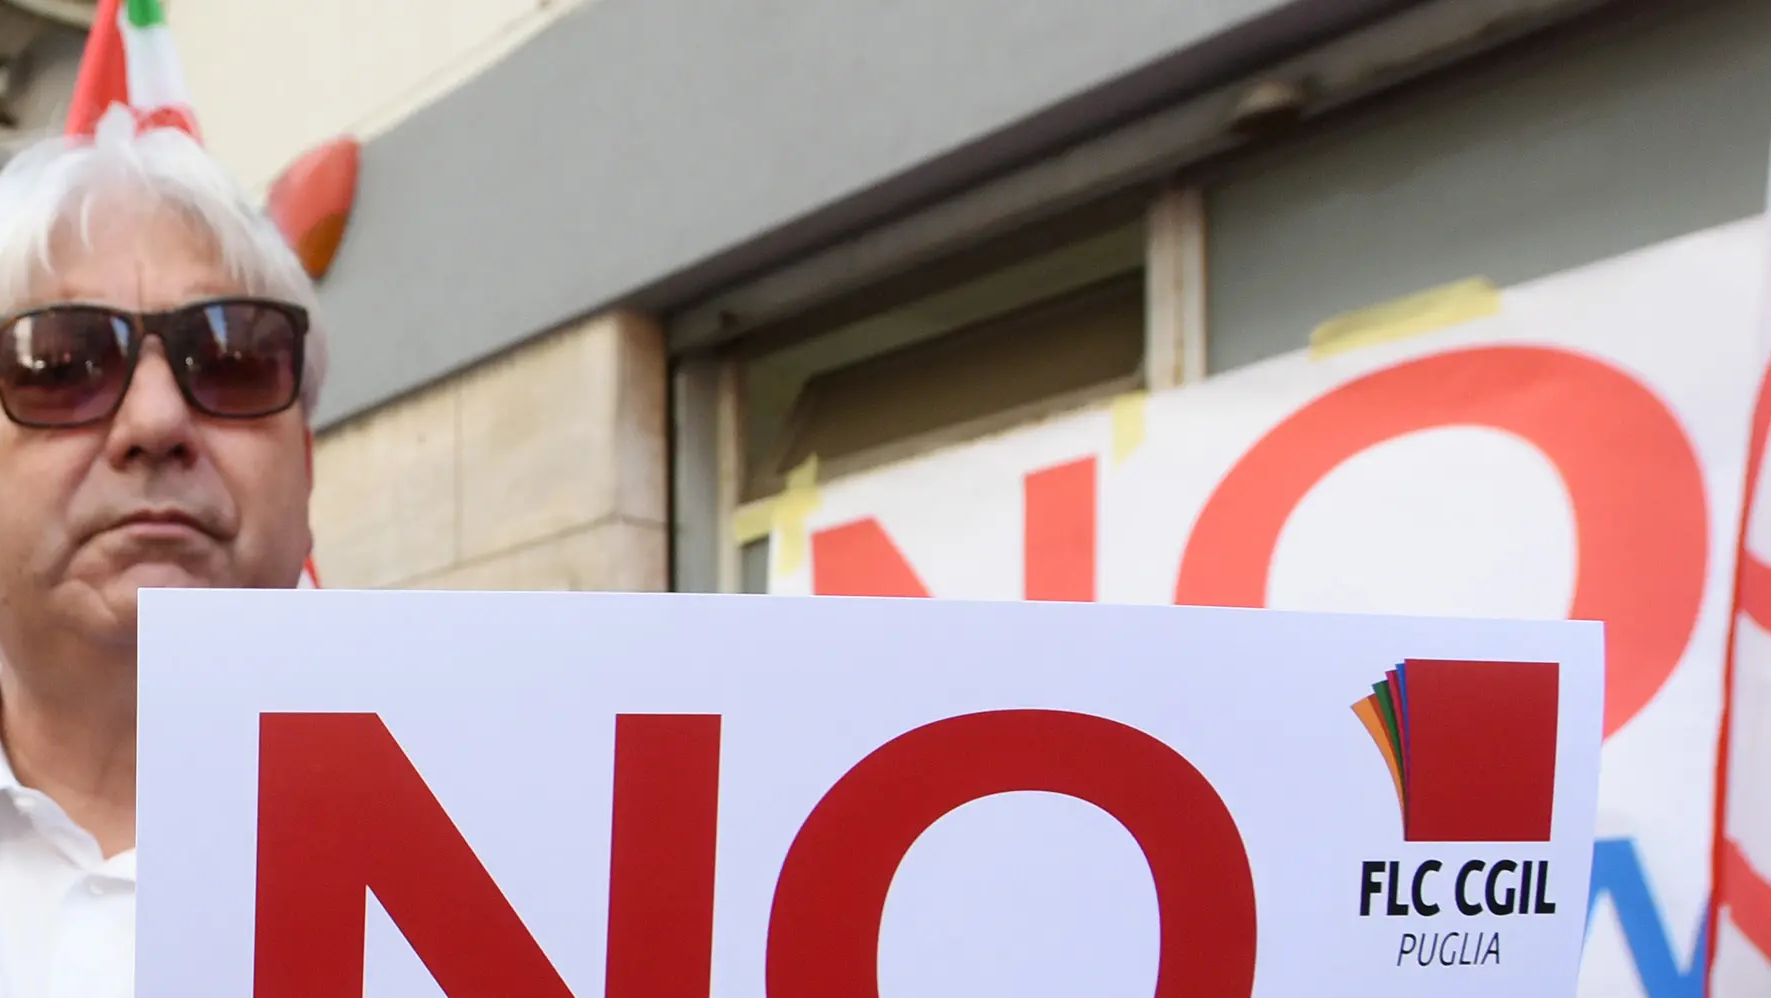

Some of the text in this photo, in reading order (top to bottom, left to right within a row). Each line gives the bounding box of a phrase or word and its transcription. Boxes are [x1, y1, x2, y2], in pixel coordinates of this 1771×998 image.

[1359, 859, 1557, 918] FLC CGIL
[1396, 931, 1502, 968] PUGLIA
